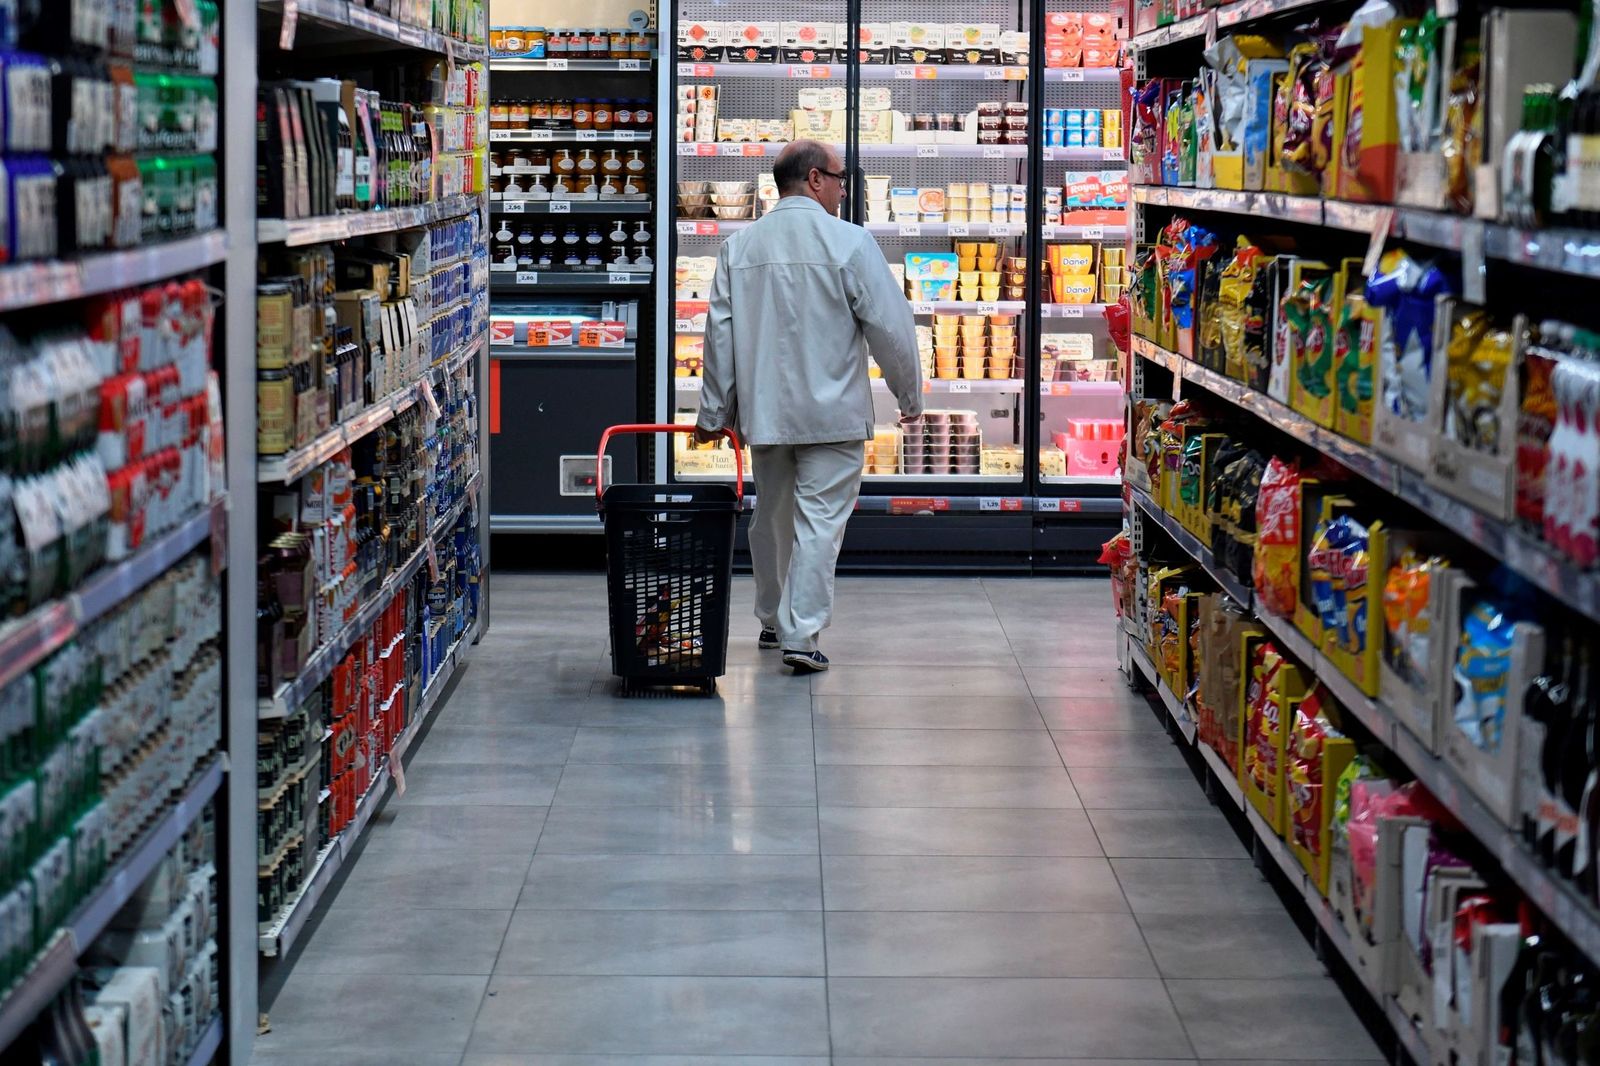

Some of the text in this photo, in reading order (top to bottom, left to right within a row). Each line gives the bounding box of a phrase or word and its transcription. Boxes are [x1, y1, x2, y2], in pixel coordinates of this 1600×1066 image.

[1071, 184, 1100, 194] Royal
[1063, 258, 1088, 266] Danet
[1066, 286, 1092, 294] Danet
[712, 455, 729, 464] Flan
